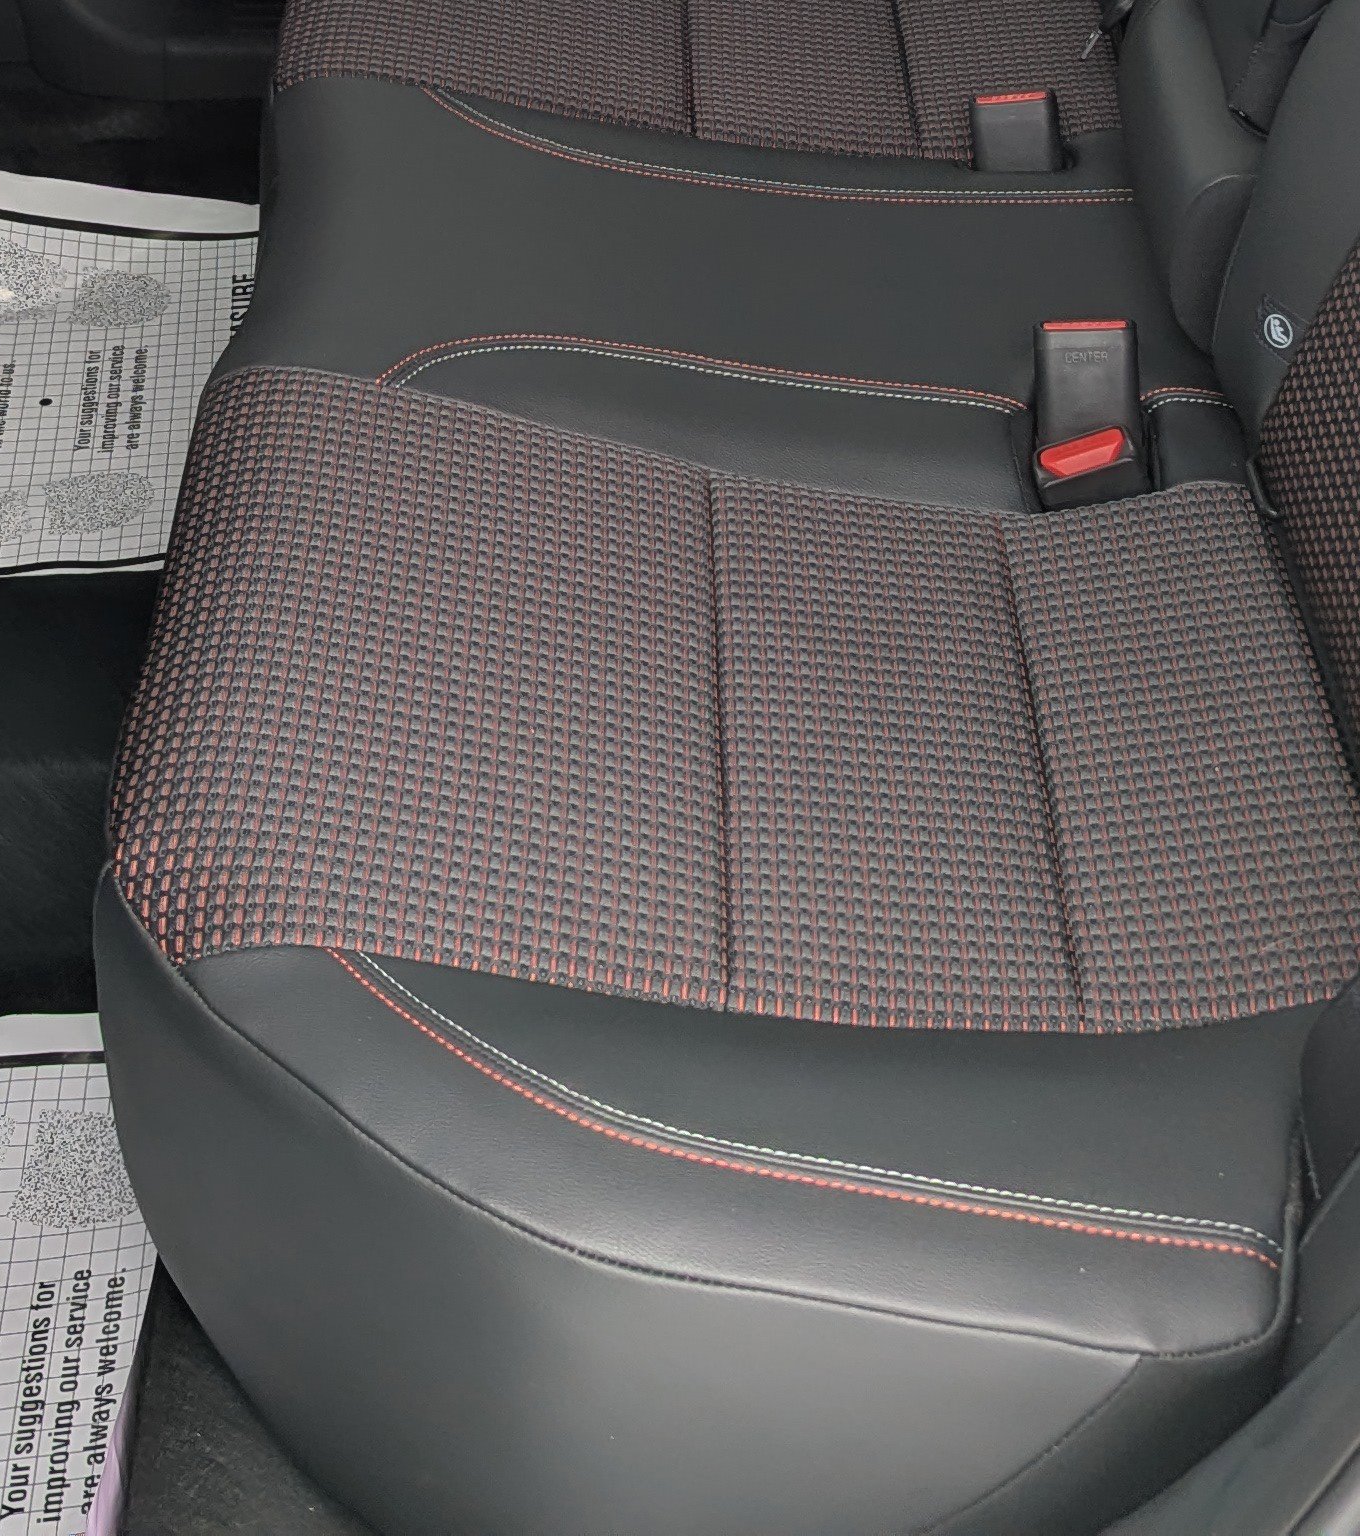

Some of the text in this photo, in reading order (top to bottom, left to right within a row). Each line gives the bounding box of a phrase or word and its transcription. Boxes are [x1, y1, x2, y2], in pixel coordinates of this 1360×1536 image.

[1065, 350, 1108, 363] CENTER
[72, 350, 102, 452] Your suggestions for
[107, 383, 121, 399] our
[125, 394, 147, 430] always
[97, 401, 122, 453] improving
[126, 432, 140, 450] are
[0, 1281, 56, 1520] Your suggestions for
[36, 1268, 91, 1524] improving our service
[81, 1267, 128, 1515] are always welcome.
